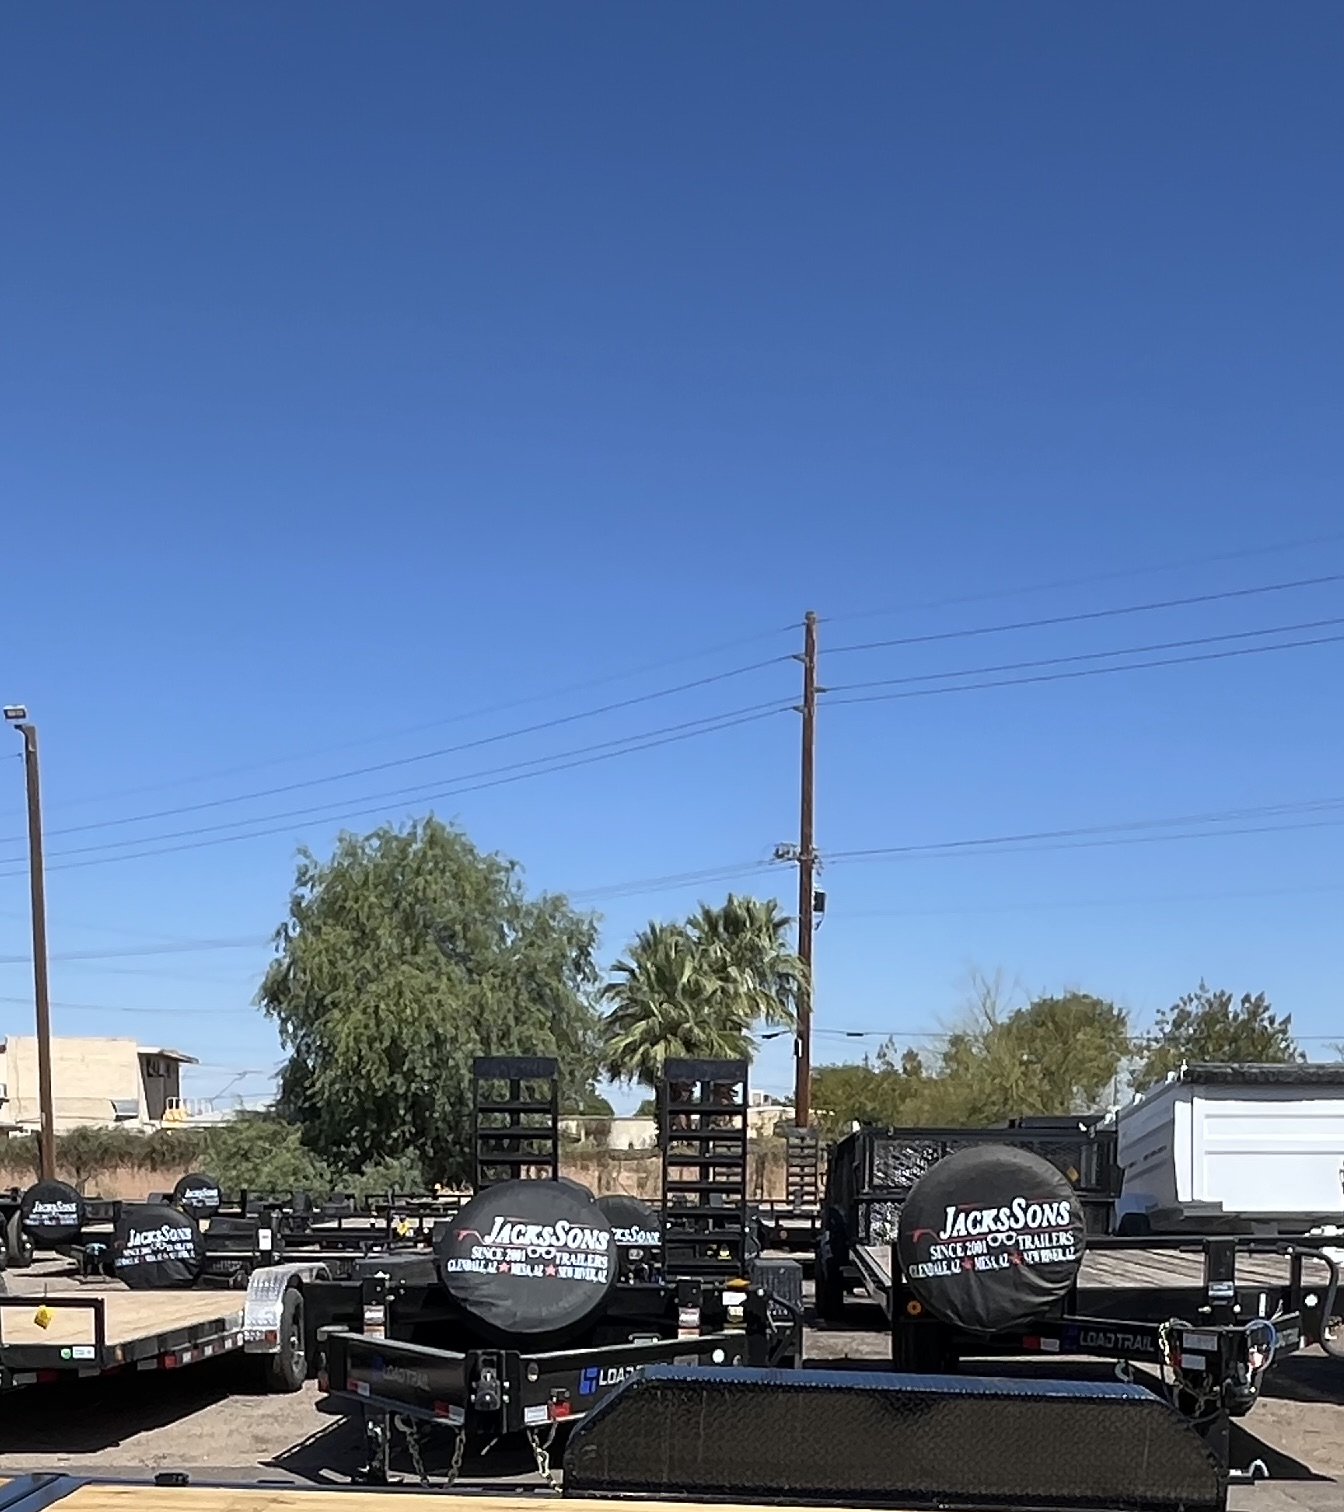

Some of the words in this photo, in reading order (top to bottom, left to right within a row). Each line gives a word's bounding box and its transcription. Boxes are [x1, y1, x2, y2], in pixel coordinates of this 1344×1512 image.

[471, 1245, 505, 1261] SINCE
[556, 1251, 609, 1269] TRAILERS
[930, 1242, 965, 1261] SINCE
[965, 1239, 988, 1256] 2001
[1017, 1231, 1075, 1250] TRAILERS
